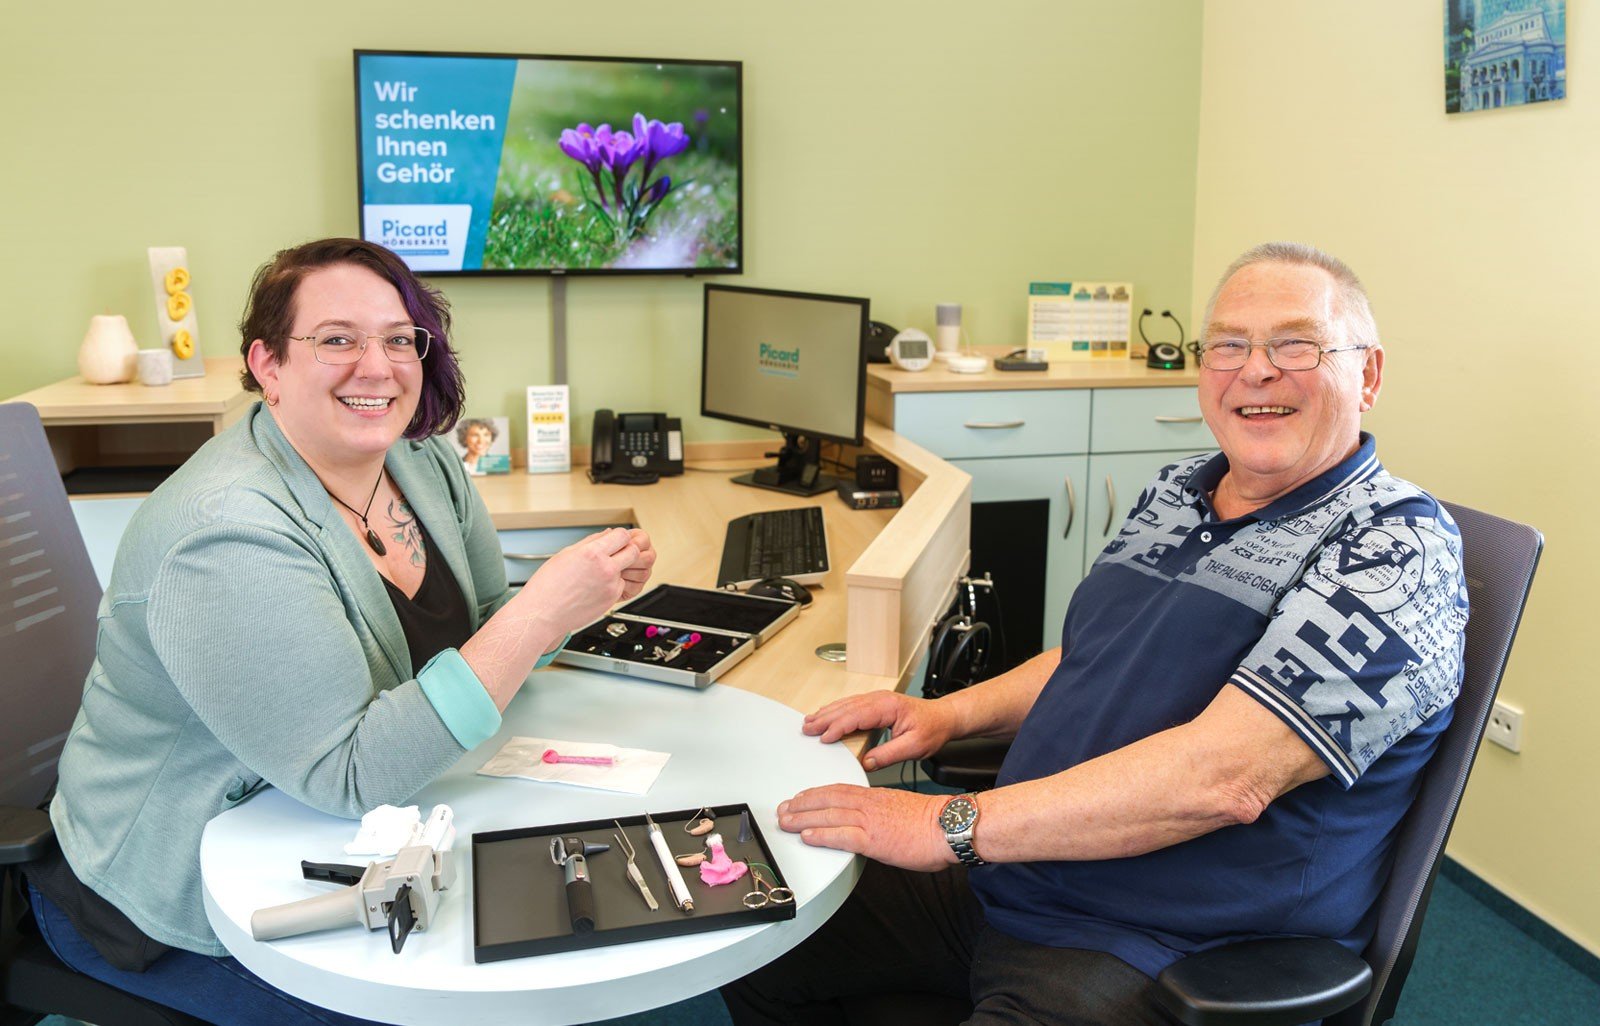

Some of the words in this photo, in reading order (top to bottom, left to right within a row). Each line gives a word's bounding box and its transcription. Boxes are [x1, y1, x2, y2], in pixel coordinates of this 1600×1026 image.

[374, 81, 418, 102] Wir
[375, 109, 496, 131] schenken
[377, 135, 447, 157] Ihnen
[377, 162, 455, 184] Gehör
[382, 219, 447, 237] Picard
[383, 238, 447, 246] HÖRGERÄTE
[759, 343, 799, 363] Picard
[1204, 559, 1222, 574] THE
[1386, 611, 1410, 634] New
